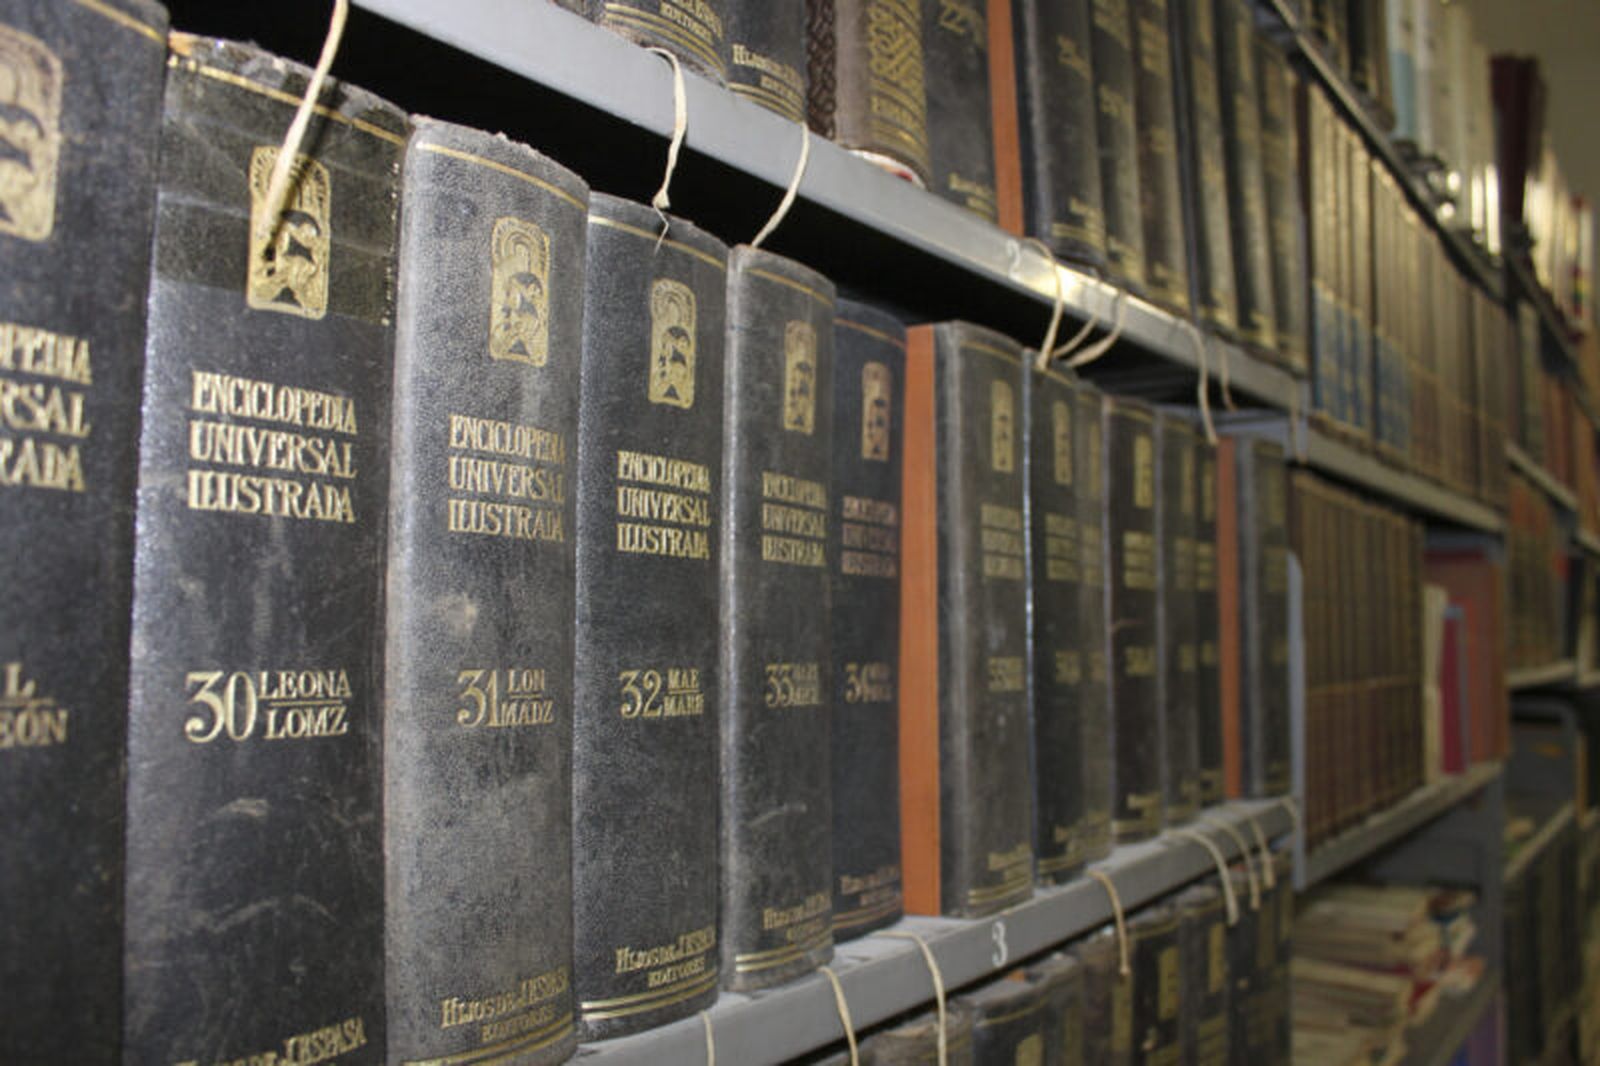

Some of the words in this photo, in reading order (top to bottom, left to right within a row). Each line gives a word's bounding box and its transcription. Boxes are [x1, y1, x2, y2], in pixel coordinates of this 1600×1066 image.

[191, 370, 357, 434] ENCICLOPEDIA
[190, 420, 357, 479] UNIVERSAL
[188, 470, 355, 523] ILUSTRADA
[450, 456, 565, 504] UNIVERSAL
[449, 499, 565, 542] ILUSTRADA
[617, 486, 711, 527] UNIVERSAL
[617, 523, 711, 560] ILUSTRADA
[258, 668, 352, 700] LEONA
[457, 669, 500, 728] 31
[507, 668, 546, 693] LON
[619, 669, 662, 719] 32
[667, 667, 699, 689] MAE
[186, 671, 257, 743] 30
[263, 705, 348, 741] LOMZ
[500, 700, 554, 727] MADZ
[991, 920, 1008, 967] 3
